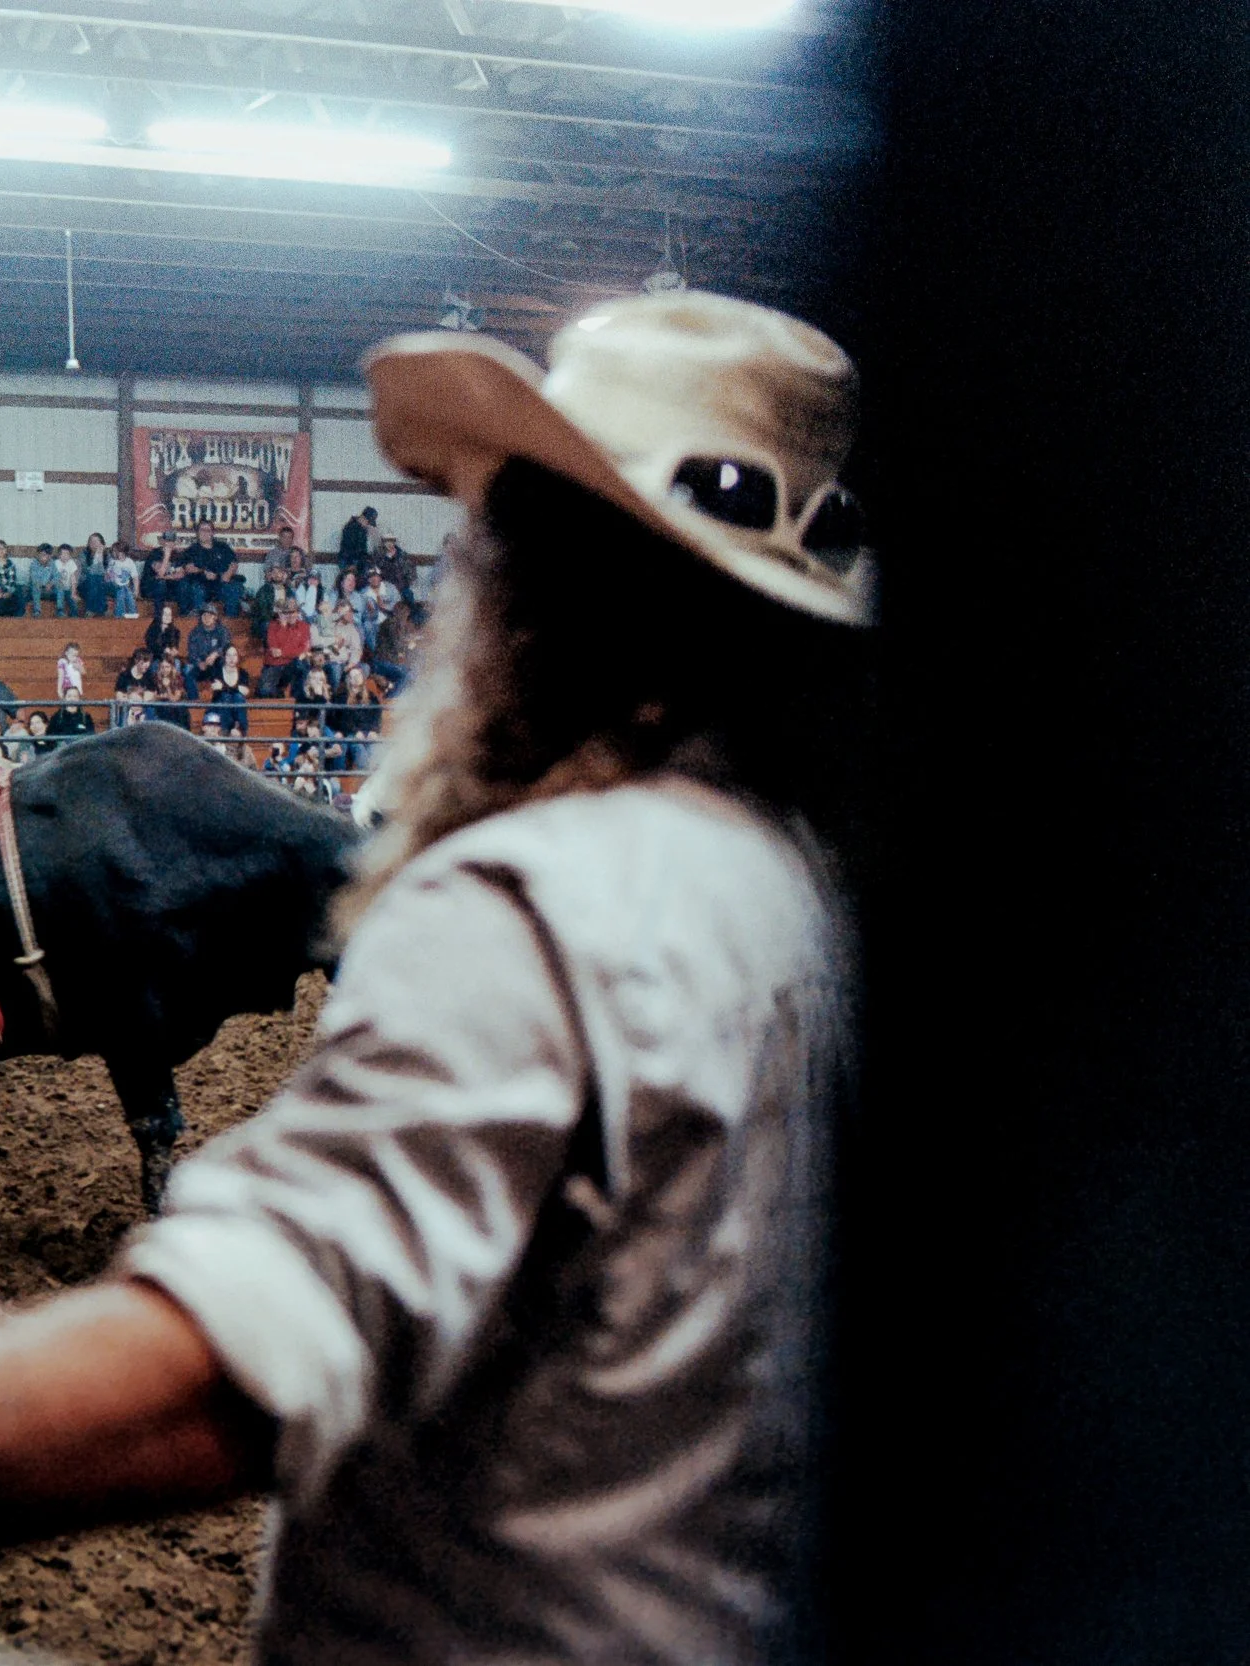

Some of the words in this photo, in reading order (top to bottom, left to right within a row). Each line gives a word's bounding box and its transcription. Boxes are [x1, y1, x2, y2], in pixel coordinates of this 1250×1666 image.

[149, 433, 192, 489] FOX
[203, 435, 294, 491] HOLLOW
[171, 497, 269, 530] RODEO
